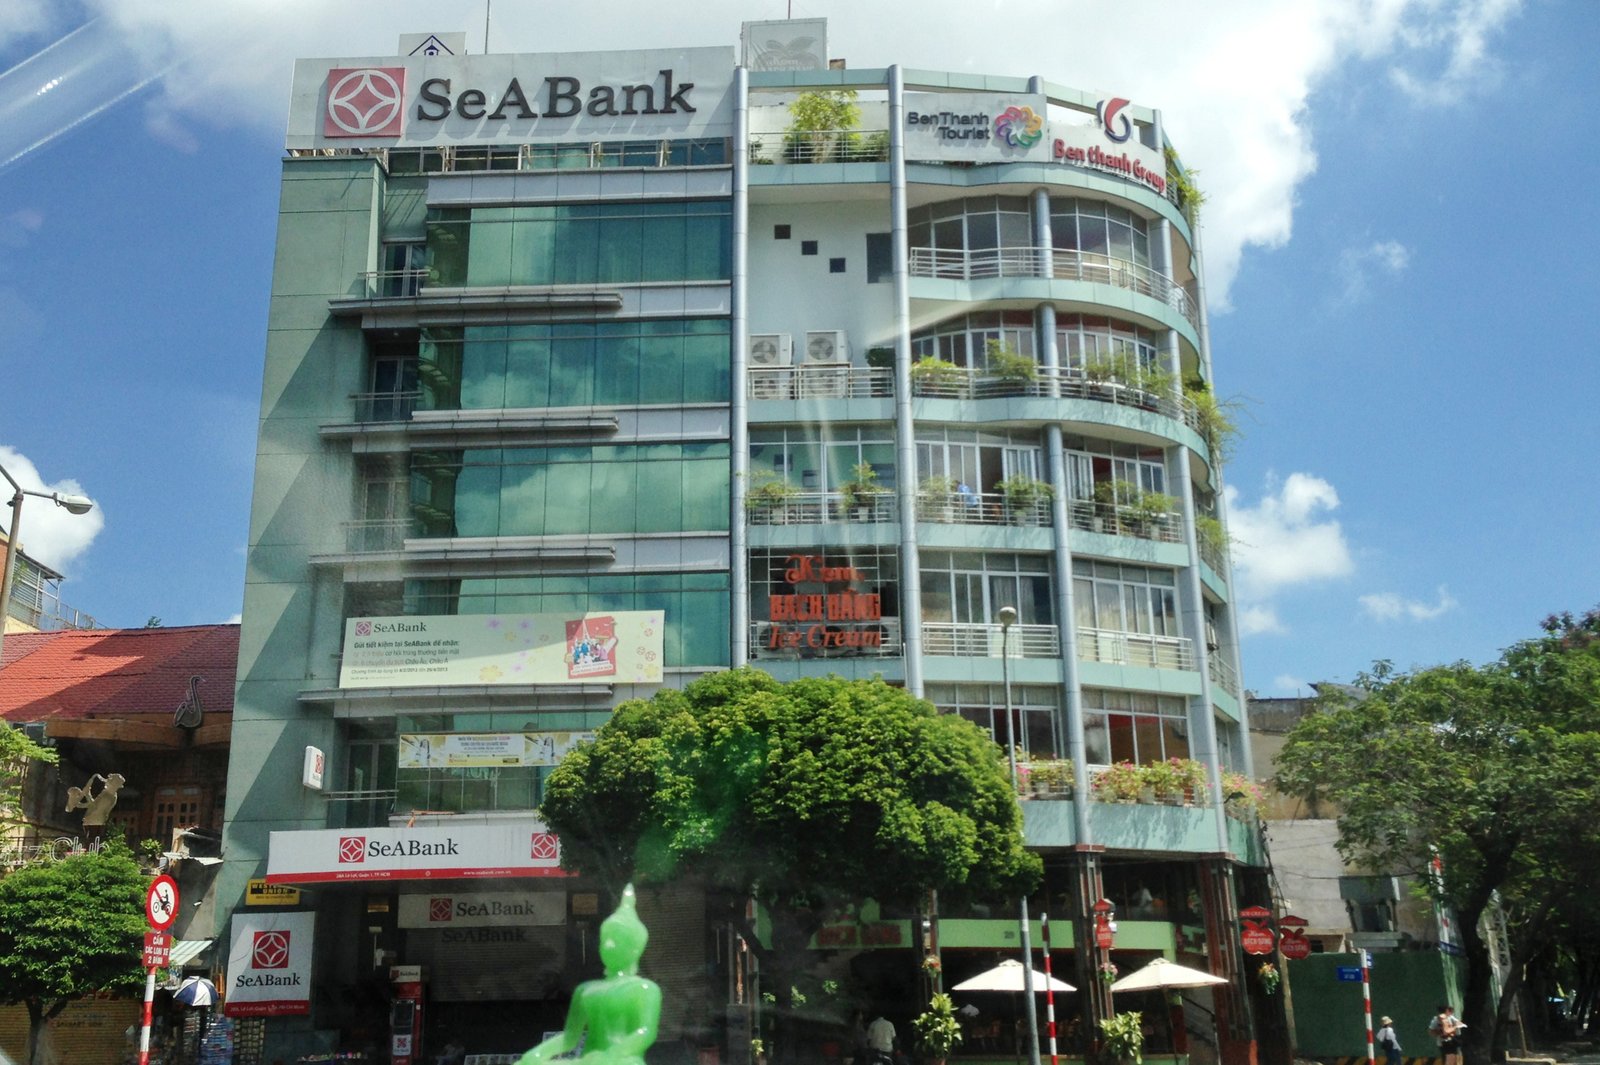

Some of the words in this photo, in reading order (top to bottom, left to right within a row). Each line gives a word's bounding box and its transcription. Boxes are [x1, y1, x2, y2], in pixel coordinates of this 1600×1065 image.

[417, 70, 697, 120] SeABank
[907, 111, 990, 125] BenThanh
[938, 126, 991, 140] Tourist
[1053, 139, 1085, 161] Ben
[1087, 144, 1131, 174] thanh
[1133, 159, 1166, 194] Group
[373, 621, 427, 633] SeABank
[403, 640, 431, 648] SeABank
[769, 625, 801, 650] Ice
[806, 623, 881, 649] Cream
[367, 837, 459, 857] SeABank
[455, 900, 536, 918] SeABank
[442, 929, 527, 943] SeABank
[147, 955, 153, 964] 2
[235, 972, 302, 988] SeABank
